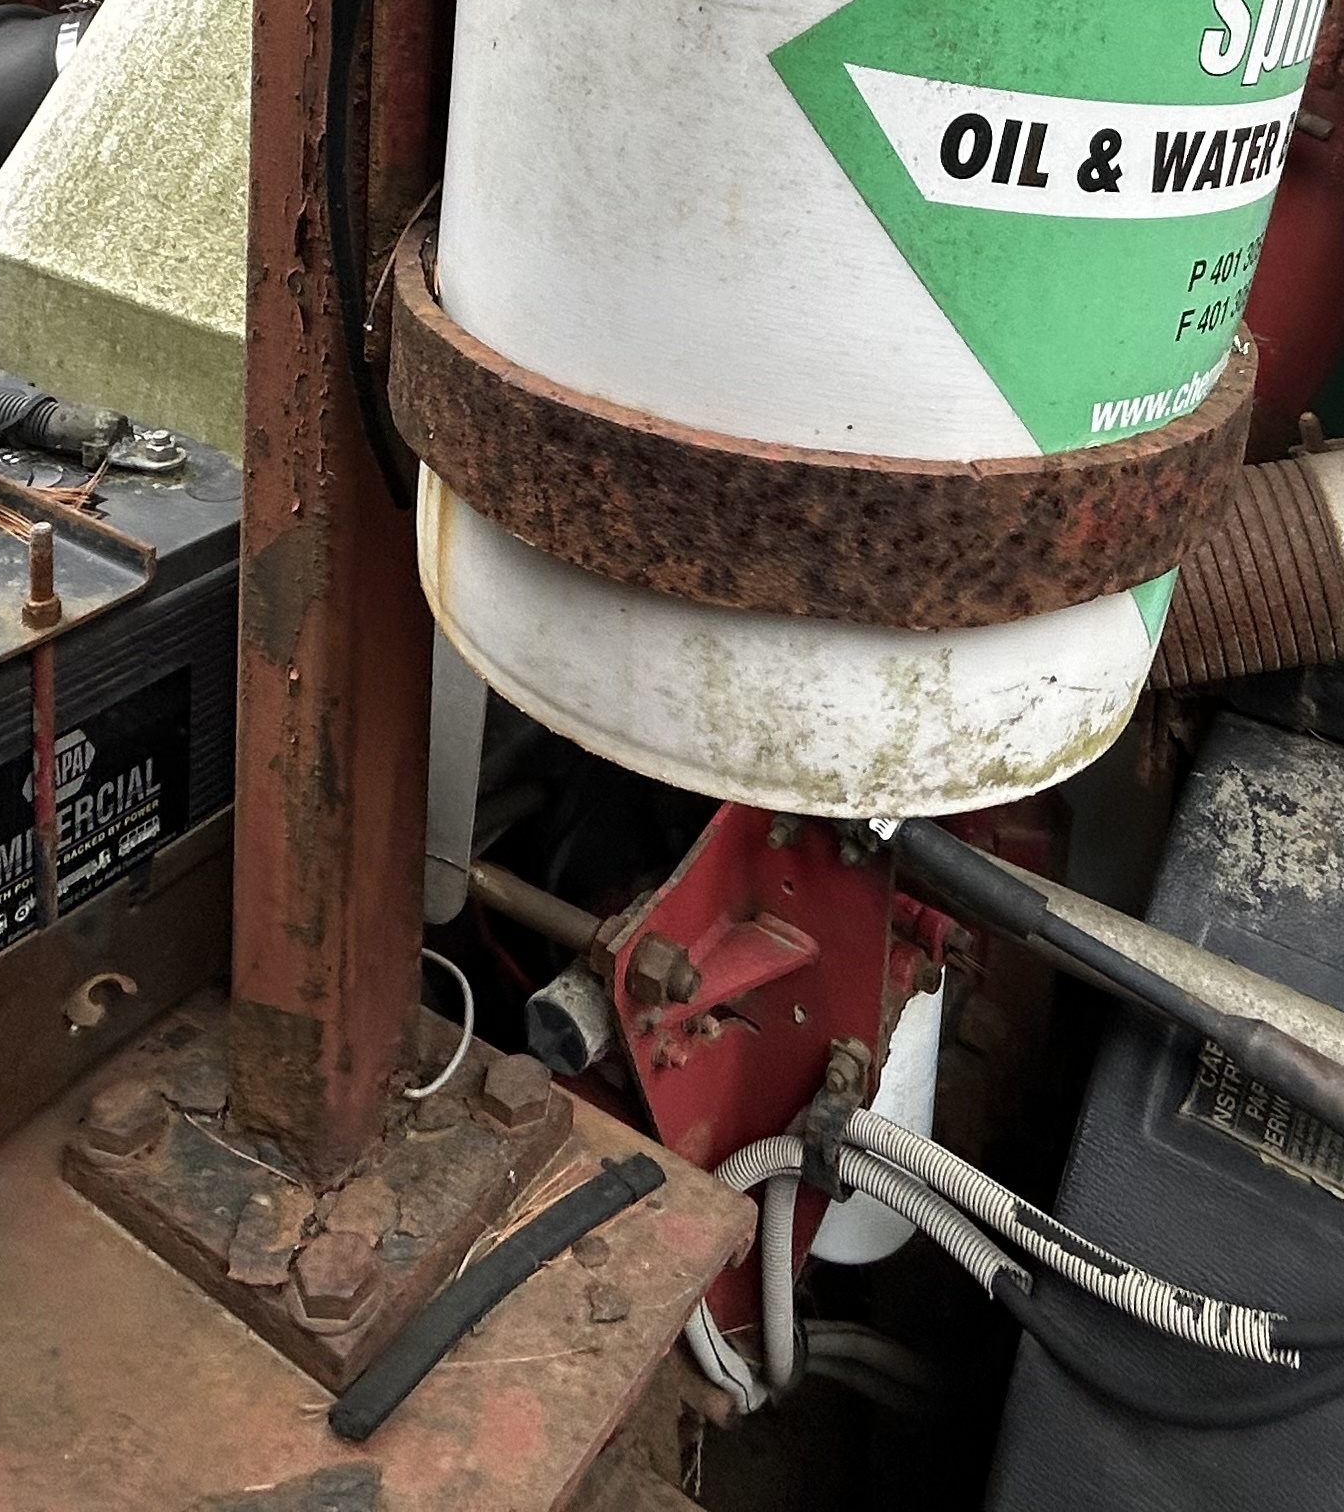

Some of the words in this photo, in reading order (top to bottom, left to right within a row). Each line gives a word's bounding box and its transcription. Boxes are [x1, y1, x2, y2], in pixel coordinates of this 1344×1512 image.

[939, 112, 1051, 189] OIL
[1076, 127, 1123, 193] &
[1151, 119, 1282, 194] WATER
[1187, 259, 1207, 292] P
[1210, 247, 1243, 285] 401
[1175, 309, 1196, 342] F
[1197, 295, 1230, 334] 401
[63, 832, 106, 864] BACKED
[124, 799, 159, 826] POWER
